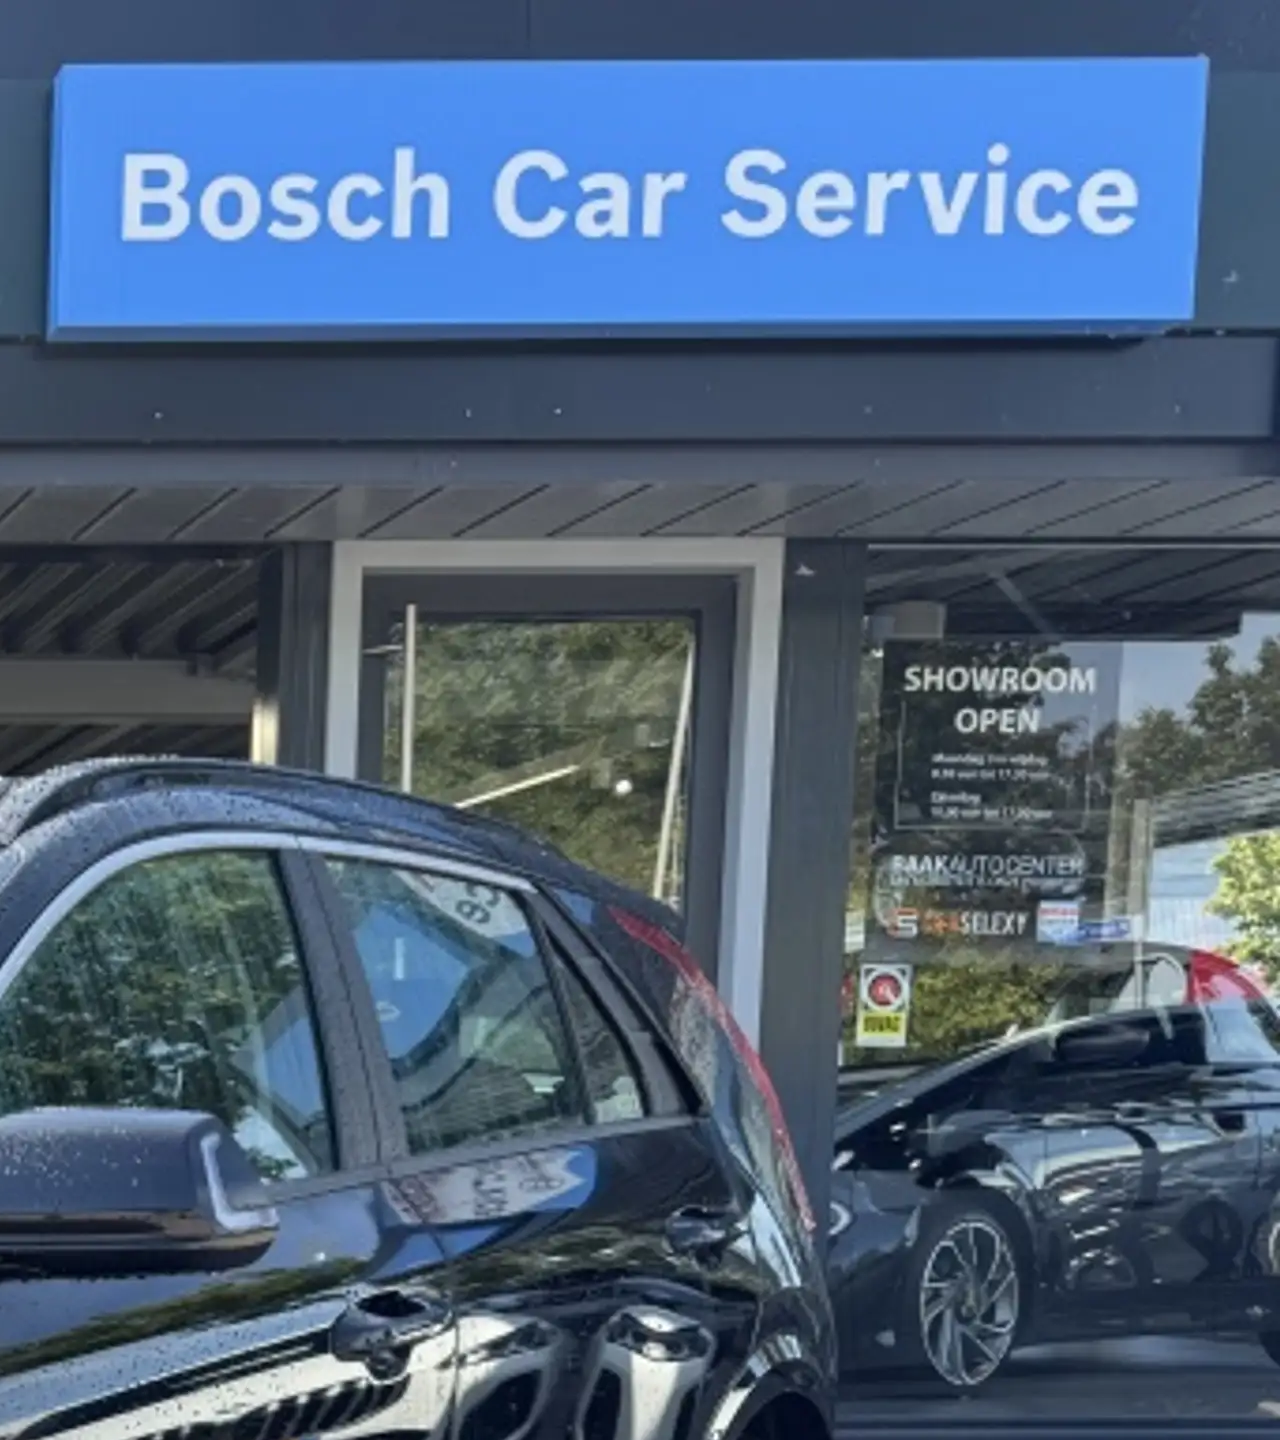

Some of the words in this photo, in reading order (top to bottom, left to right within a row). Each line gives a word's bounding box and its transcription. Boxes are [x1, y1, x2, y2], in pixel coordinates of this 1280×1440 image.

[118, 145, 452, 243] Bosch
[491, 148, 688, 241] Car
[718, 141, 1140, 240] Service
[903, 664, 1097, 694] SHOWROOM
[953, 707, 1041, 734] OPEN
